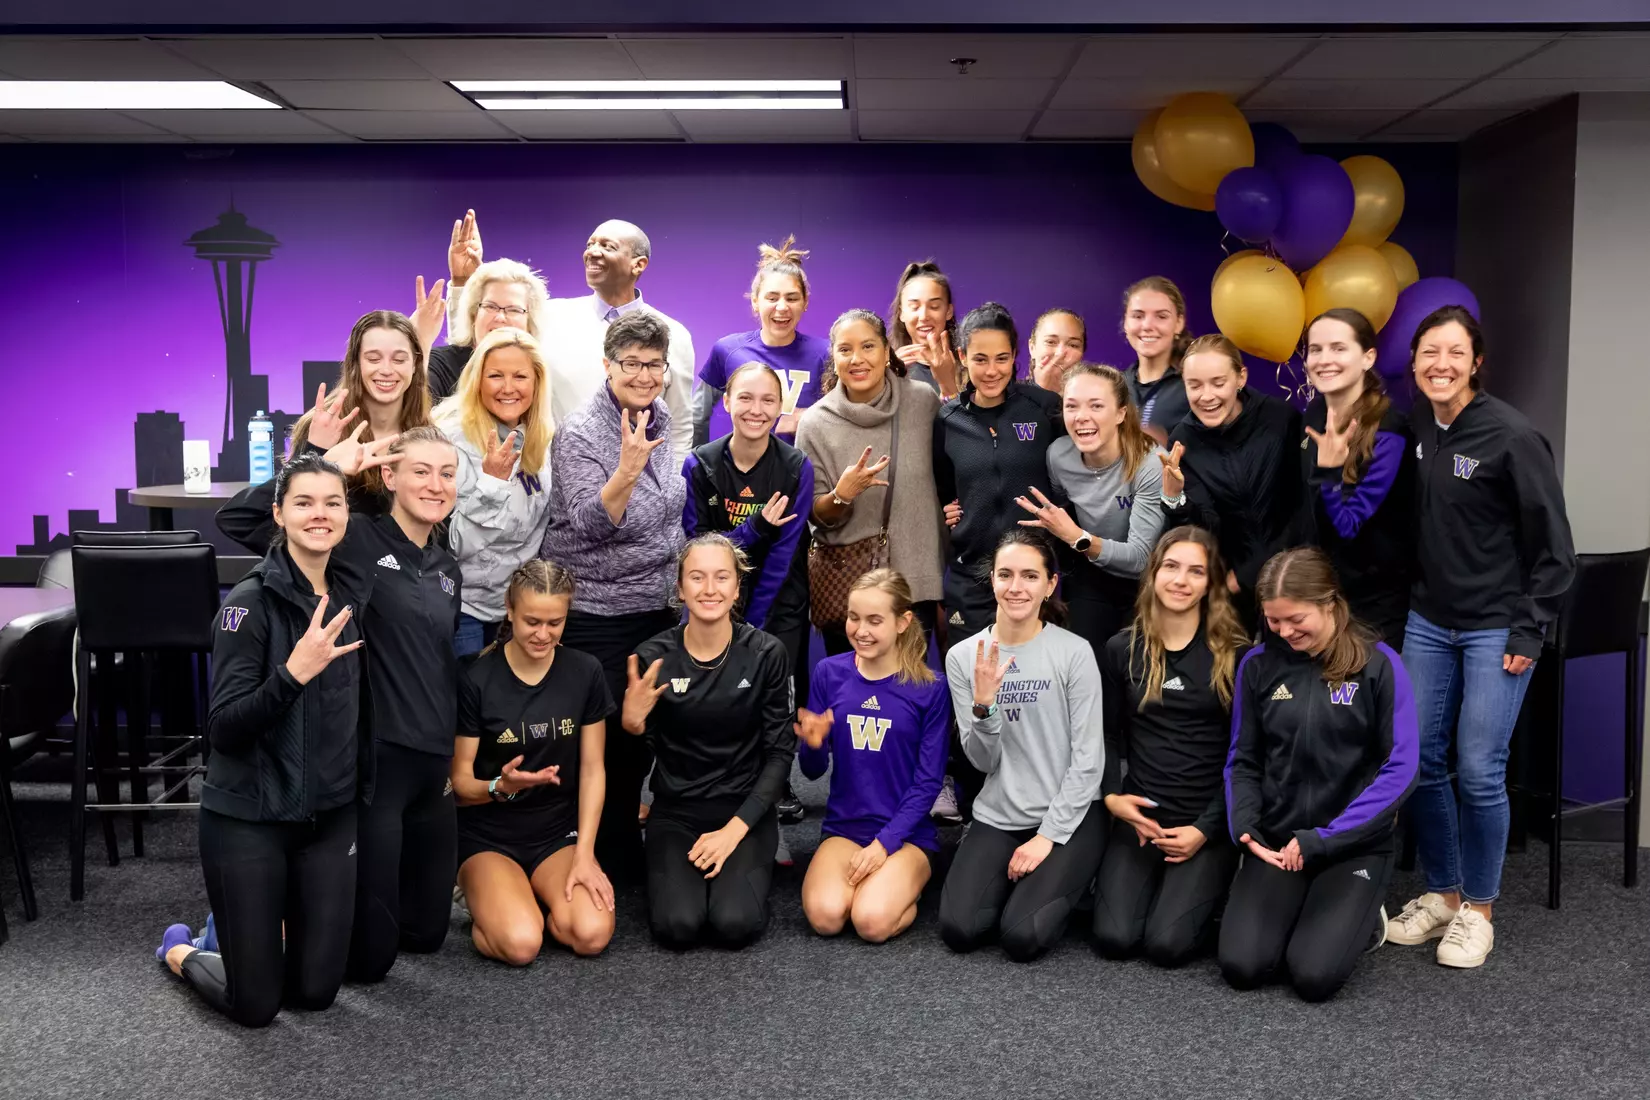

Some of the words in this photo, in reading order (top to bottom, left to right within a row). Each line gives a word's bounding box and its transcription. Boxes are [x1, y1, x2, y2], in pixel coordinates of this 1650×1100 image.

[1012, 422, 1038, 441] W
[1453, 453, 1480, 480] W
[438, 570, 455, 596] W
[221, 606, 249, 632] W
[670, 678, 691, 693] W
[998, 680, 1052, 693] HINGTON
[1327, 681, 1359, 705] W
[861, 703, 881, 711] adidas
[996, 692, 1038, 705] USKIES
[1004, 708, 1021, 722] W
[529, 723, 549, 739] W
[846, 714, 892, 752] W
